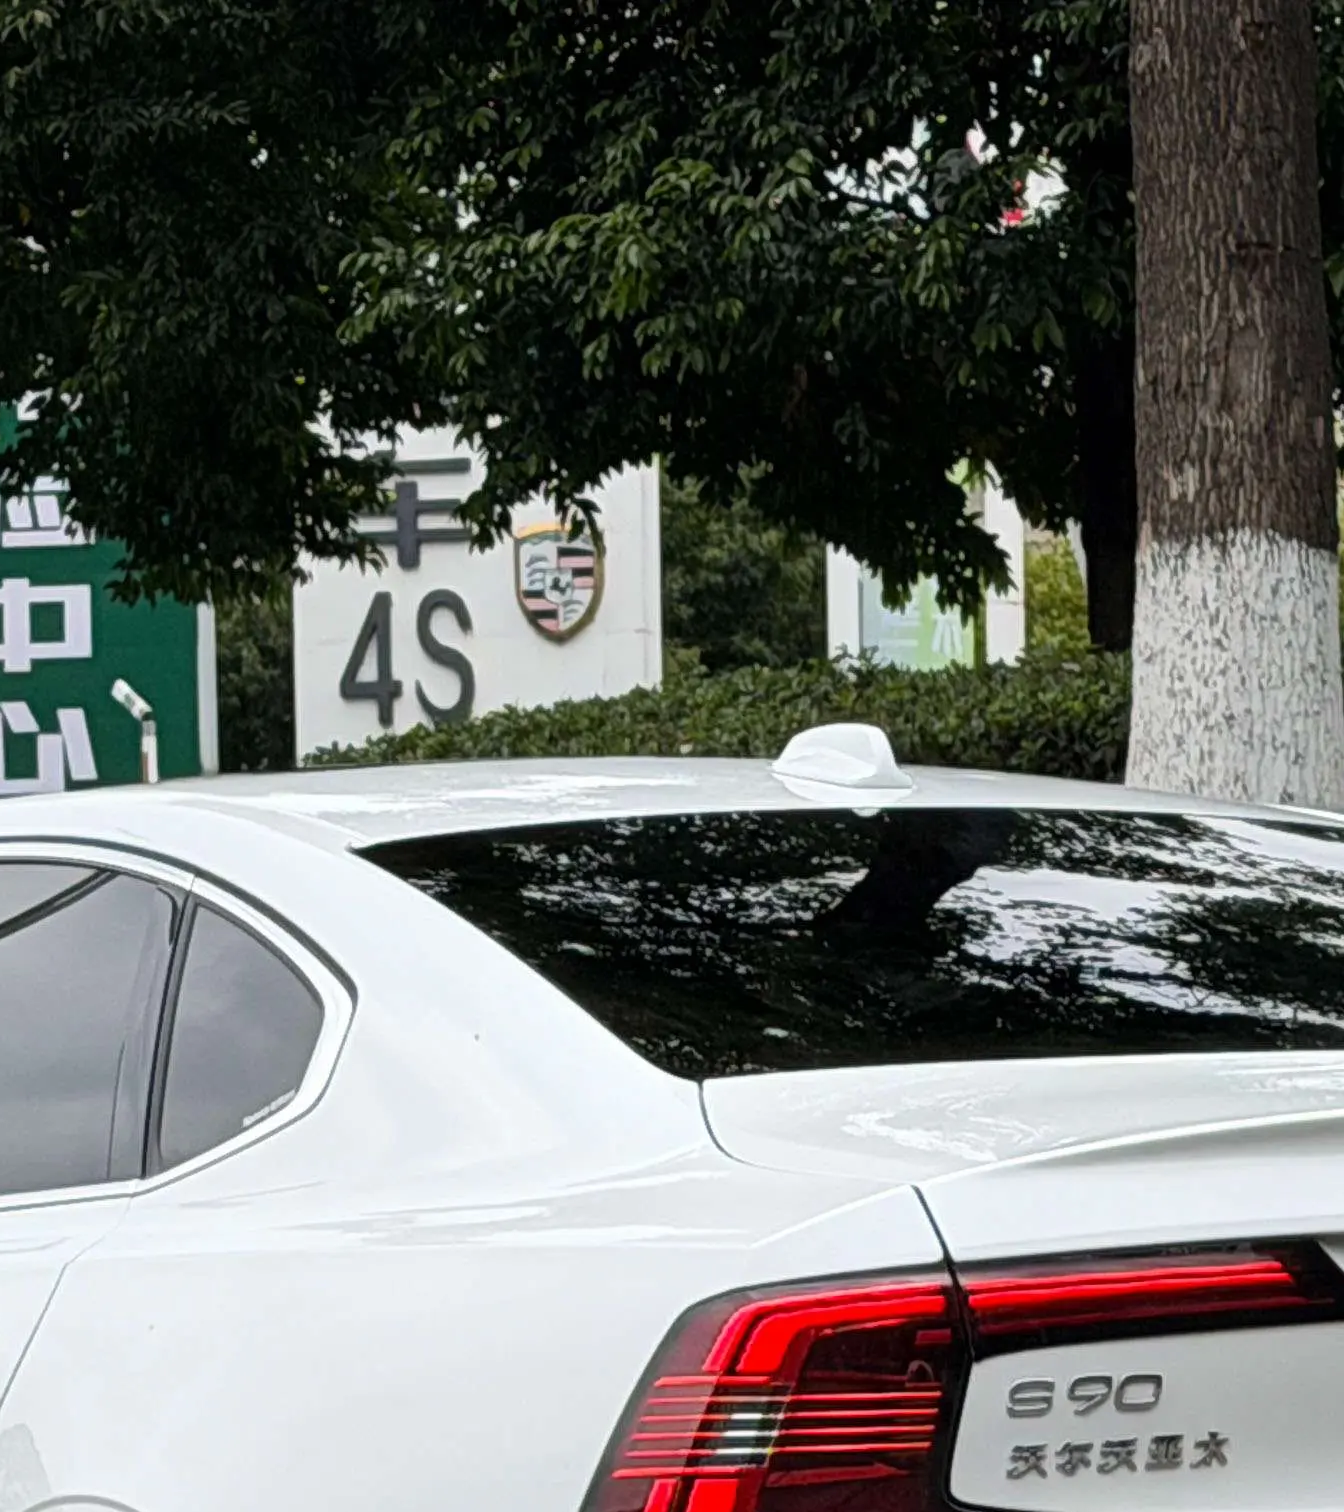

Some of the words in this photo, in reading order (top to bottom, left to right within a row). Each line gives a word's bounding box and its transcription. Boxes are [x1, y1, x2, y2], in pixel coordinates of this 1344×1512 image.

[339, 588, 476, 729] 4S
[1006, 1373, 1164, 1419] S90
[1005, 1431, 1231, 1480] 沃尔沃亚太
